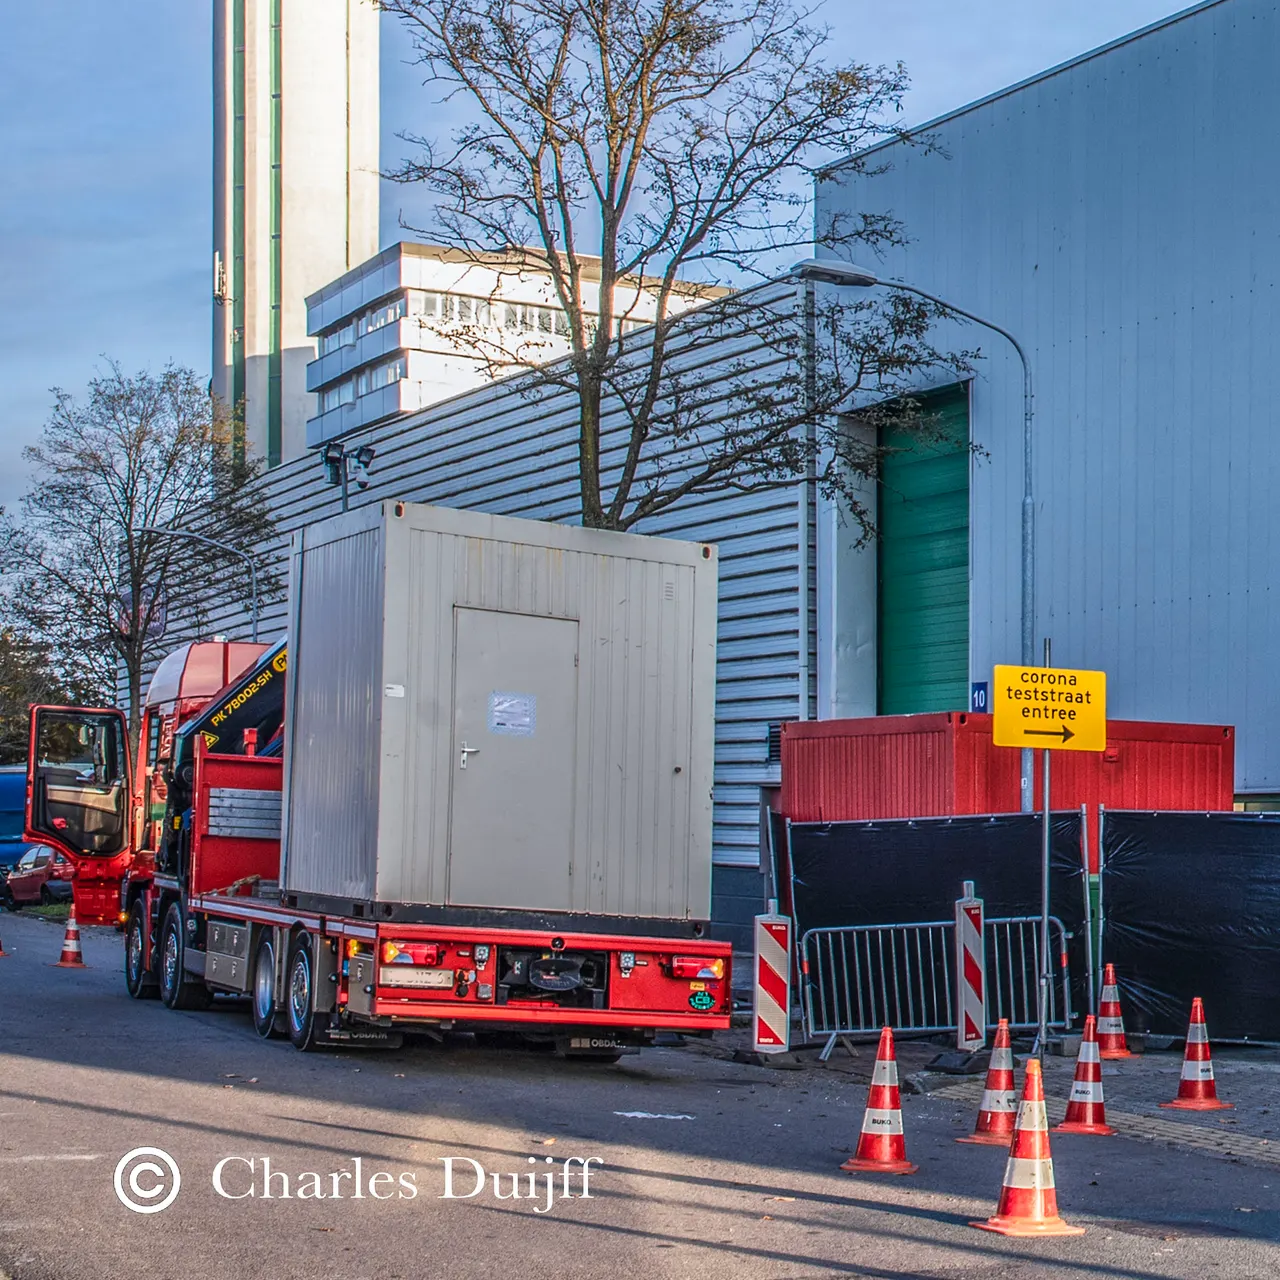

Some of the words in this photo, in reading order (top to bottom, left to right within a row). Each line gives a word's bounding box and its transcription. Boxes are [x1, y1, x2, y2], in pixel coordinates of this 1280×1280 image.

[1020, 672, 1078, 686] corona
[211, 710, 228, 727] PK
[225, 670, 274, 715] 78002-SH
[973, 689, 986, 708] 10
[1006, 686, 1092, 704] teststraat
[1021, 705, 1077, 720] entree
